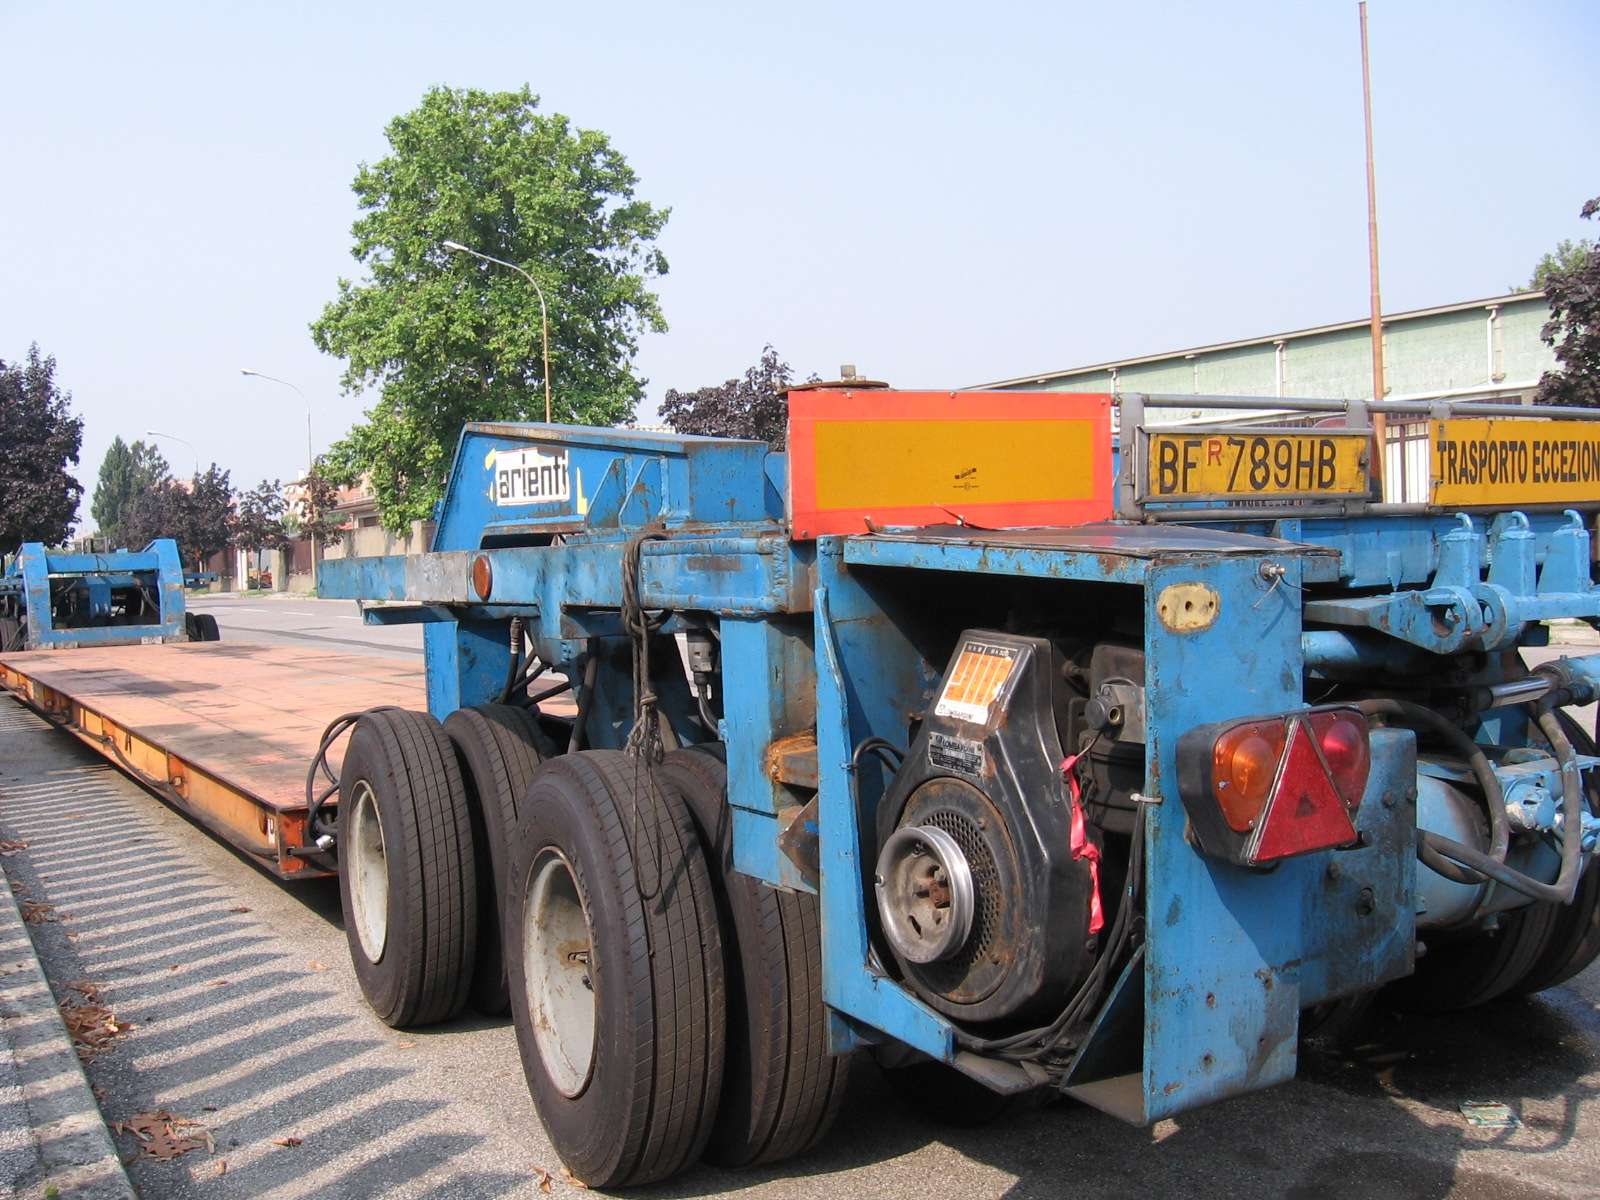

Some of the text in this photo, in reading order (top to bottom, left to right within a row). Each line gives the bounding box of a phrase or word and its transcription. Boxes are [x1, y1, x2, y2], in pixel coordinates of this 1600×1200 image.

[499, 450, 567, 498] arienti
[1437, 440, 1600, 484] TRASPORTO ECCEZION
